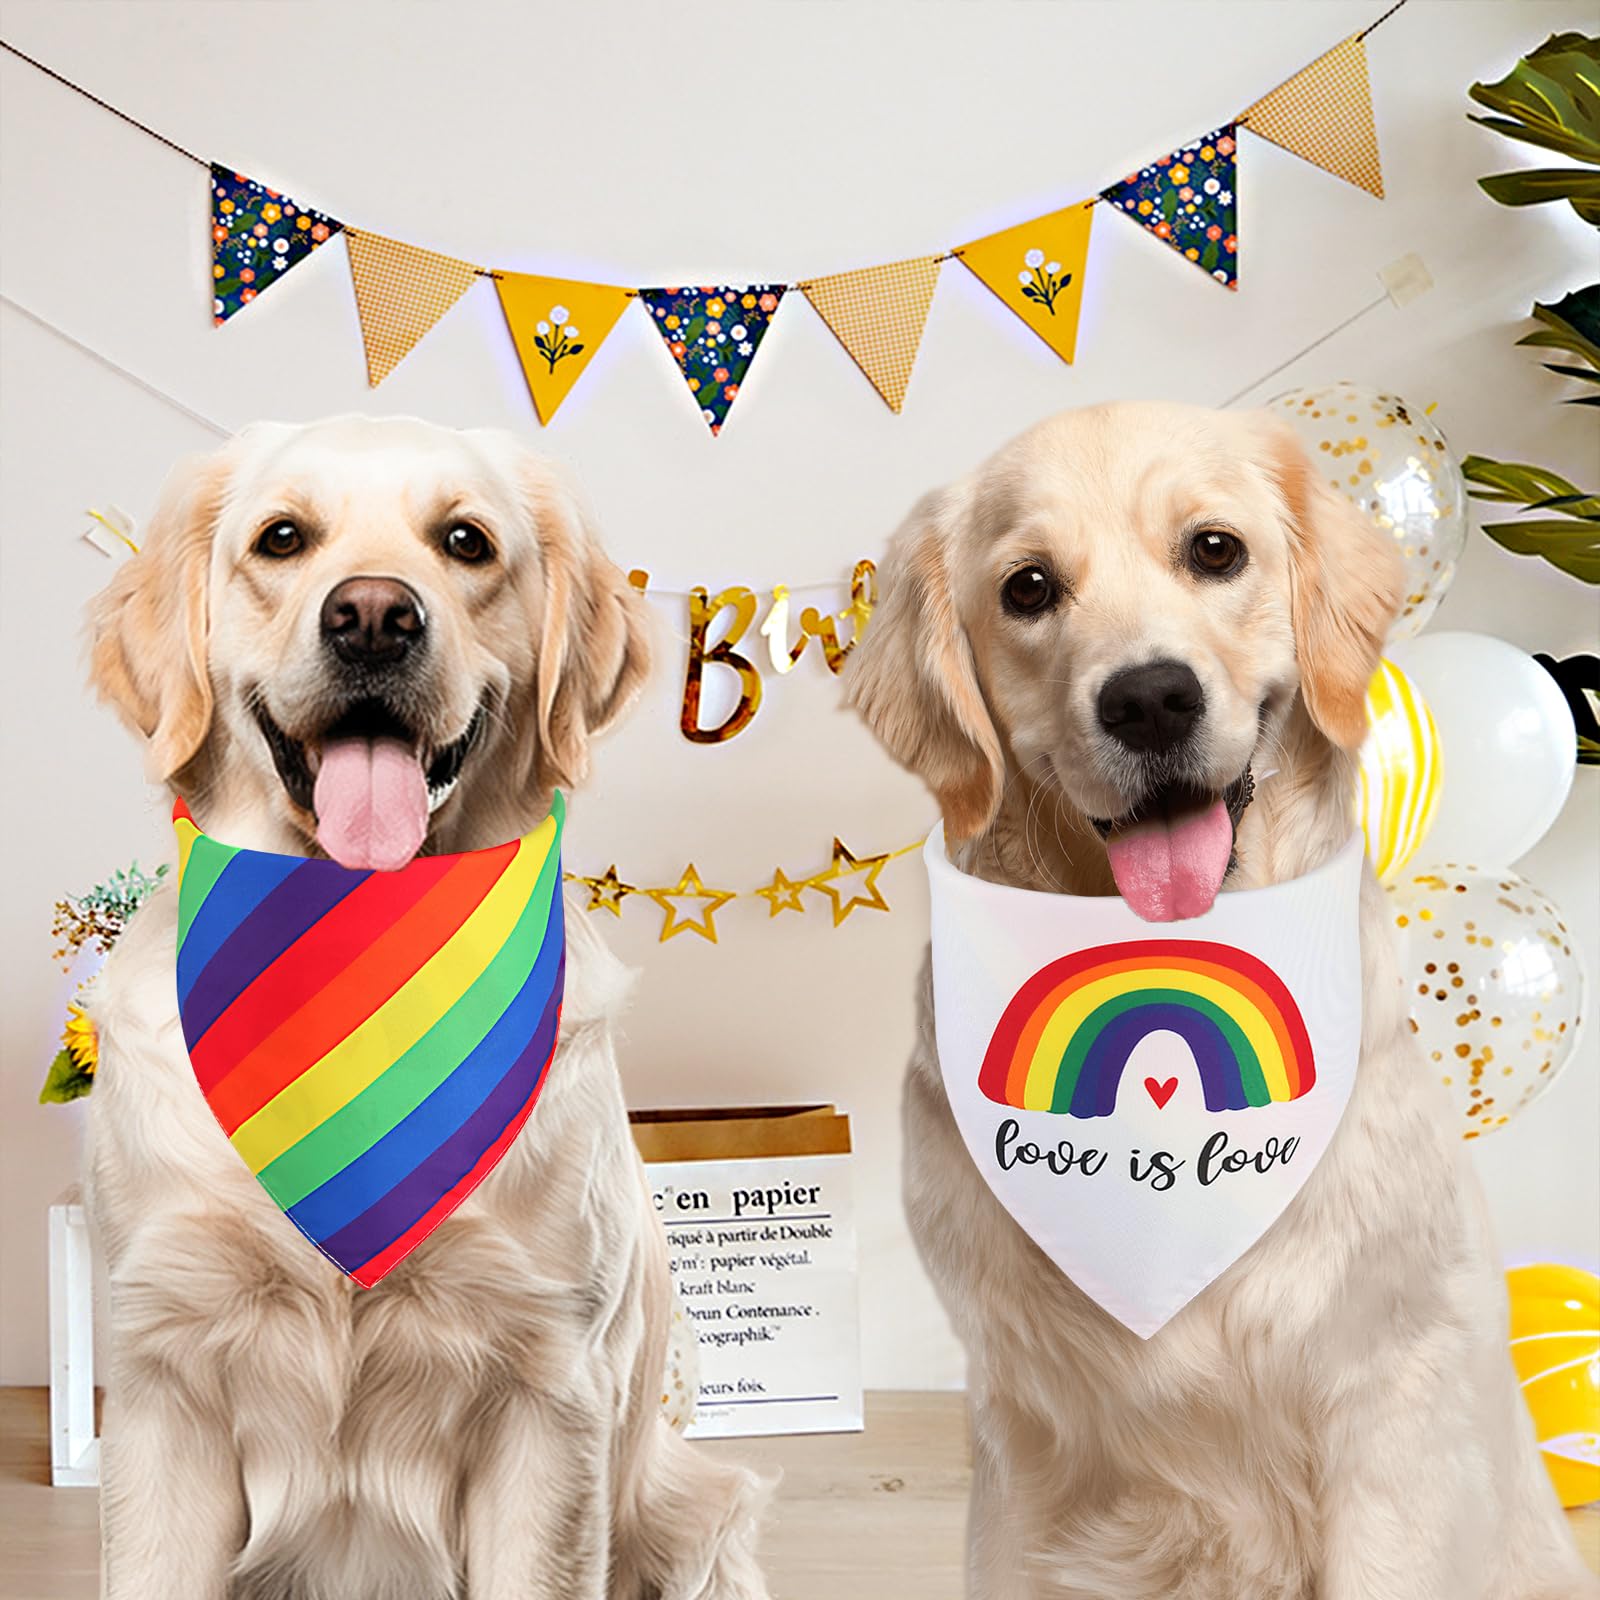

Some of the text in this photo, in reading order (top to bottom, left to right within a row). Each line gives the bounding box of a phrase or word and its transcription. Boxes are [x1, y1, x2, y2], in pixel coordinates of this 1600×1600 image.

[995, 1118, 1301, 1192] love is love
[676, 1190, 710, 1211] en
[732, 1180, 821, 1217] papier
[706, 1230, 715, 1244] à
[717, 1225, 758, 1248] partir
[759, 1226, 779, 1242] de
[780, 1224, 832, 1242] Double
[710, 1253, 756, 1273] papier
[679, 1279, 756, 1296] kraft blanc
